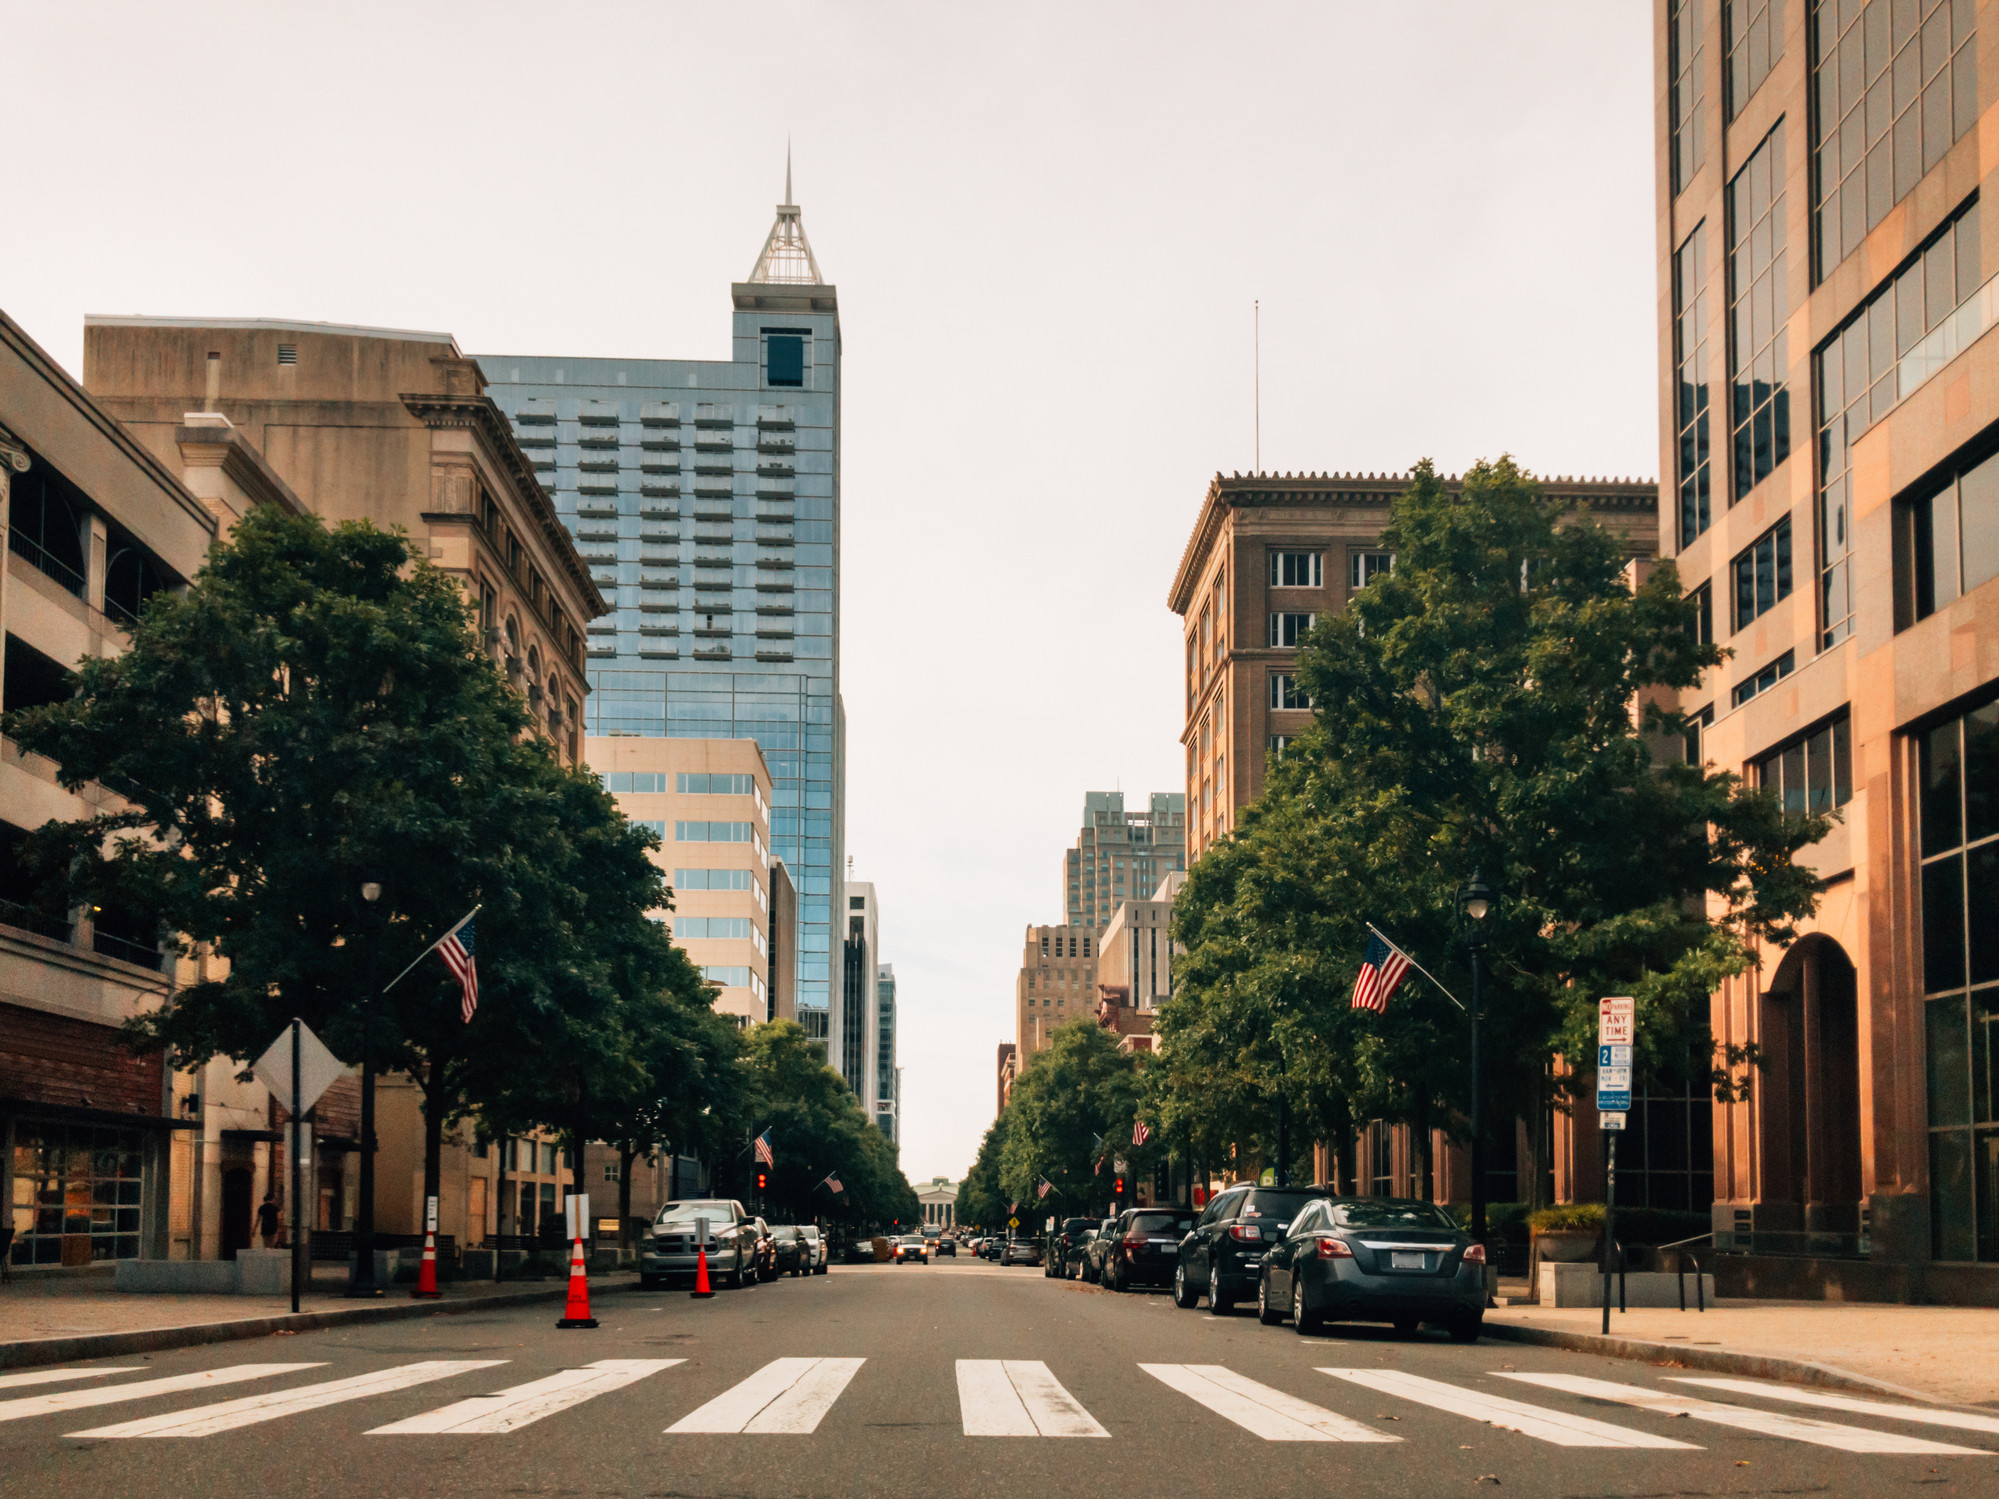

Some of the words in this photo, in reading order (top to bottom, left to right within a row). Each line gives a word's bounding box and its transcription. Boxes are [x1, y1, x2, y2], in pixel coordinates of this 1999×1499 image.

[1602, 1002, 1611, 1012] NO
[1606, 1015, 1626, 1025] ANY
[1605, 1026, 1627, 1036] TIME
[1602, 1049, 1609, 1064] 2
